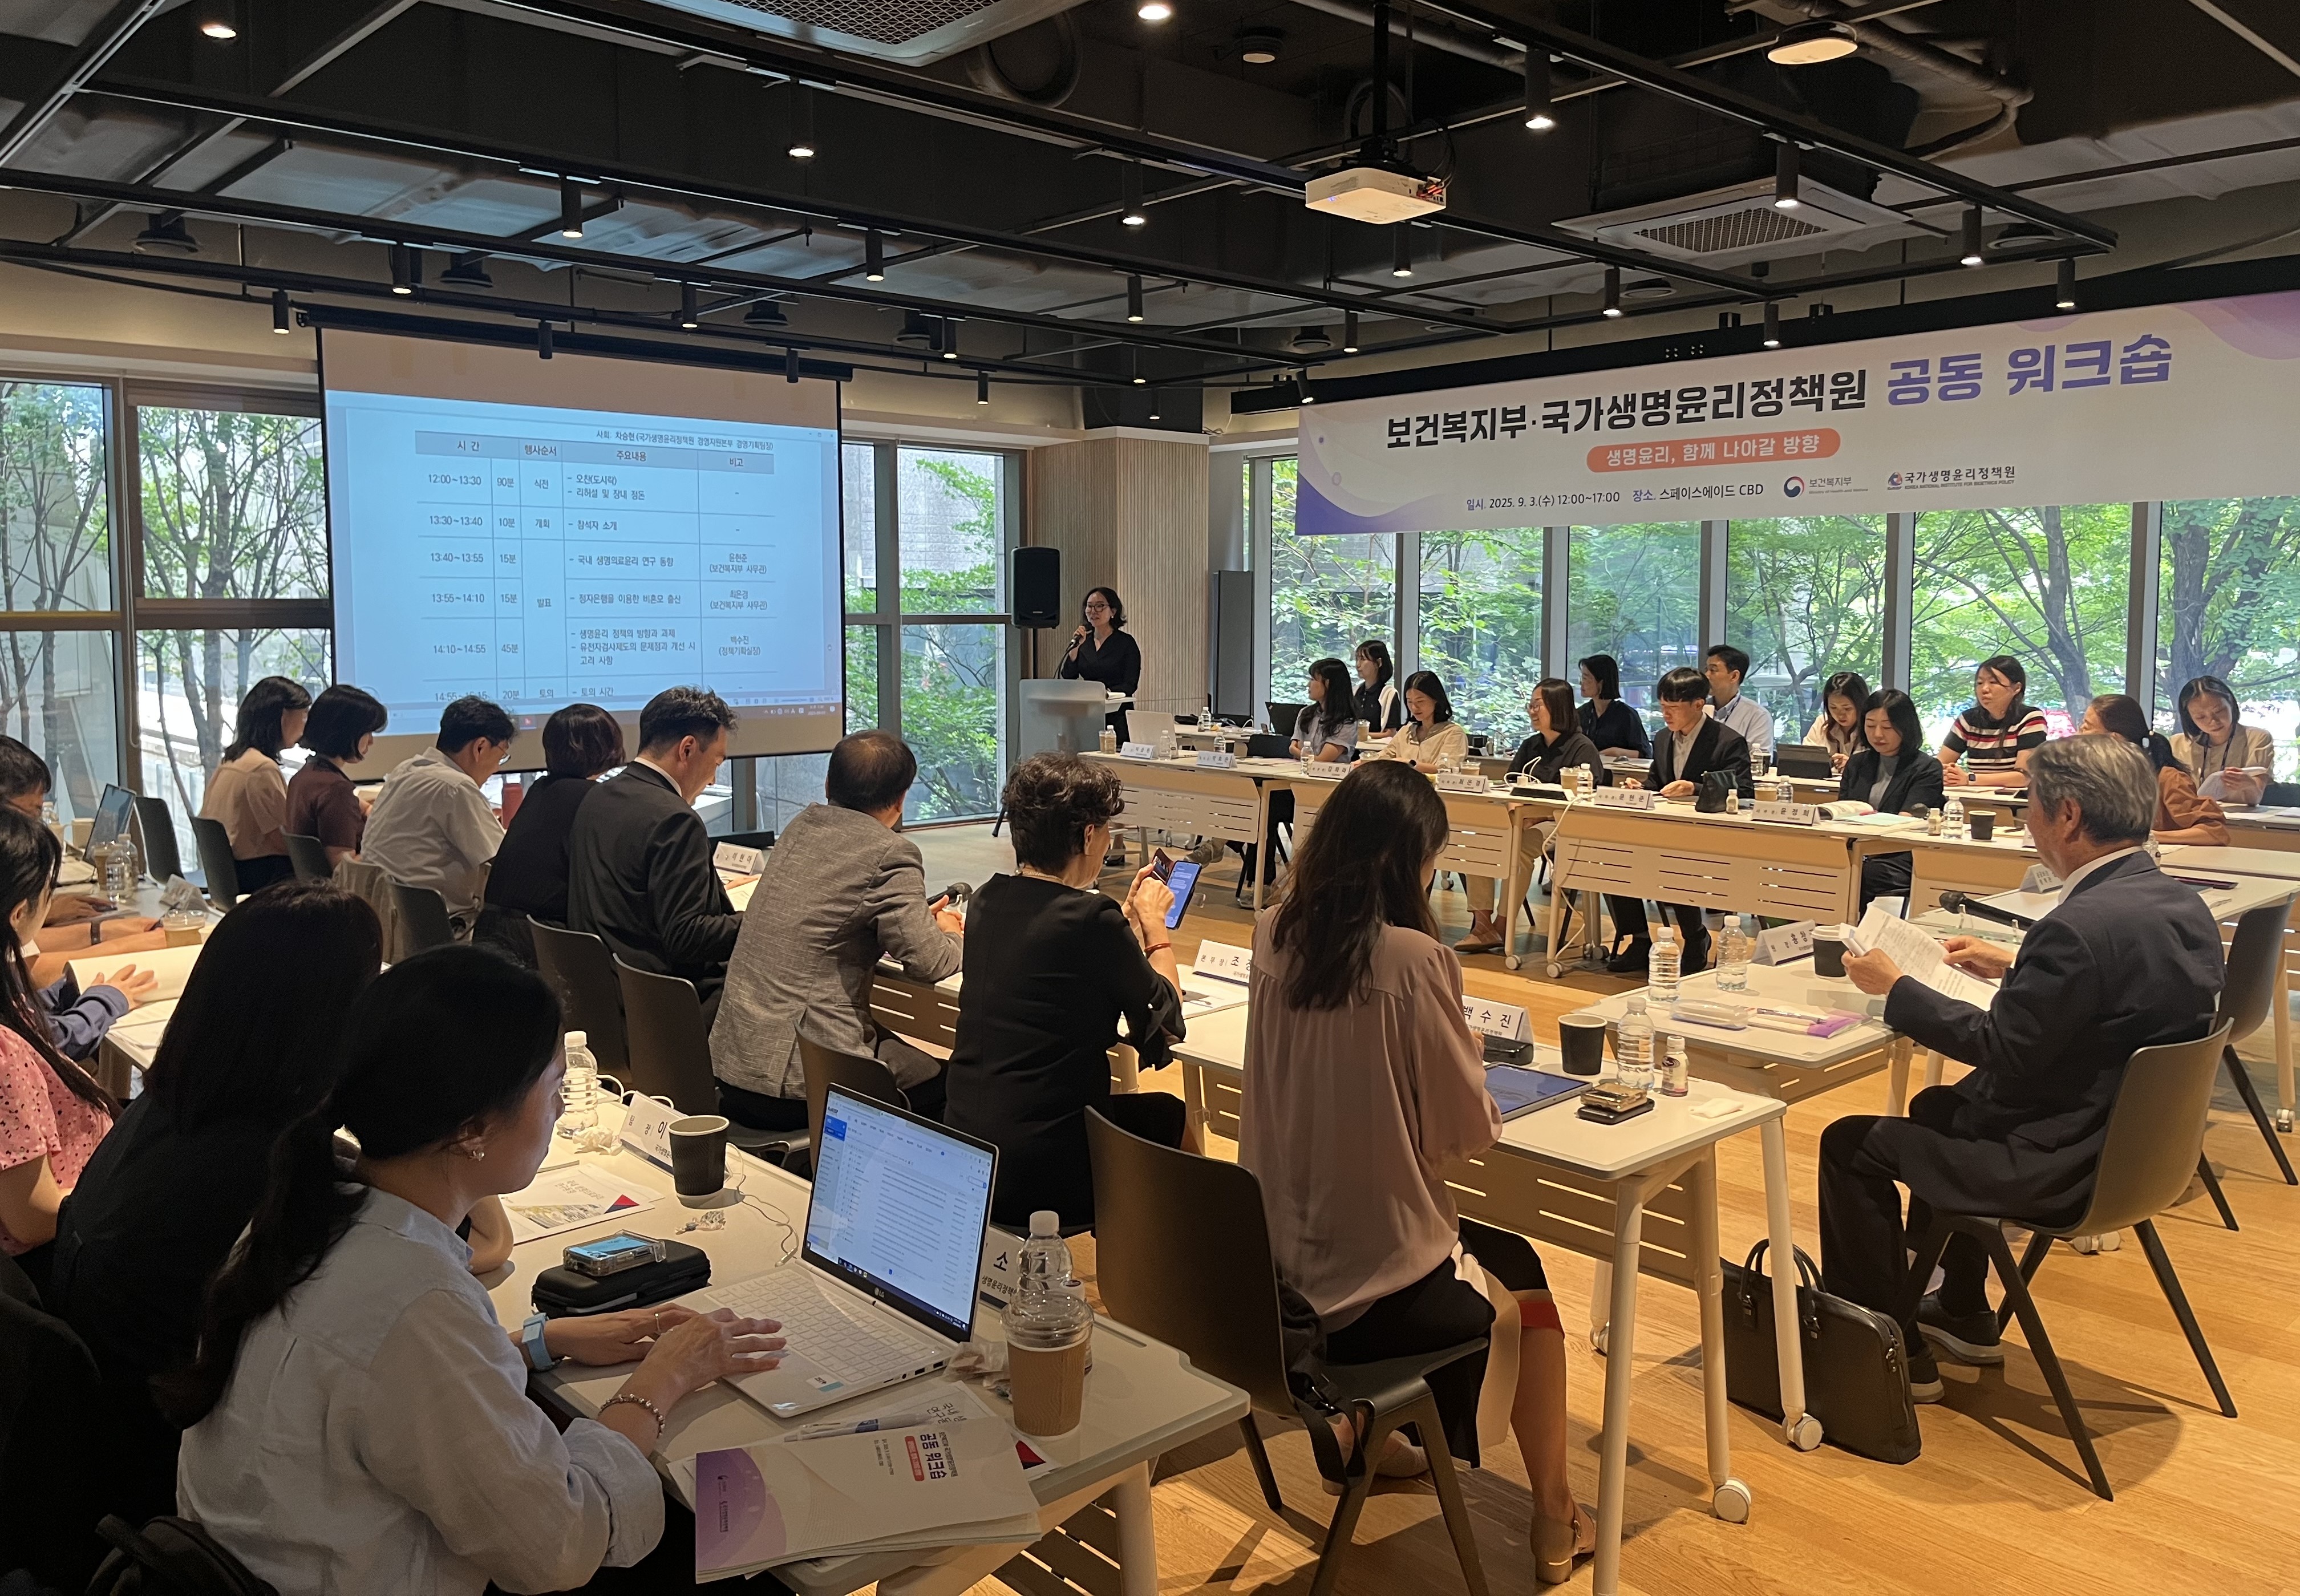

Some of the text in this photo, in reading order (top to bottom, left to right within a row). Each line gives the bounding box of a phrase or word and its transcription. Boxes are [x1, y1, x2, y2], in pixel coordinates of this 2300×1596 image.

[1387, 333, 2173, 449] 보건복지부·국가생명윤리정책원 공동 워크숍
[524, 444, 557, 456] 행사순서
[1606, 434, 1820, 467] 생명윤리, 함께 나아갈 방향
[616, 450, 647, 461] 주요내용
[729, 458, 743, 467] 비고
[428, 474, 481, 485] 12:00~13:30
[1904, 465, 2015, 484] 국가생명윤리정책원
[496, 477, 515, 488] 90분
[534, 479, 549, 489] 식전
[576, 475, 617, 485] 오찬(도시락)
[1809, 476, 1852, 488] 보건복지부
[577, 488, 645, 501] 리허설 및 장내 정돈
[1489, 496, 1515, 509] 2025.
[1517, 496, 1527, 508] 9.
[1529, 495, 1555, 508] 3.(수)
[1557, 491, 1621, 506] 12:00~17:00
[1659, 485, 1735, 500] 스페이스에이드
[1739, 484, 1764, 496] CBD
[430, 516, 483, 526] 13:30~13:40
[499, 517, 516, 528] 10분
[535, 519, 550, 529] 개회
[577, 520, 617, 530] 참석자 소개
[430, 553, 484, 563] 13:40~13:55
[500, 553, 517, 564] 15분
[578, 555, 674, 567] 국내 생명의료윤리 연구 동향
[709, 564, 767, 574] (보건복지부 사무관)
[432, 593, 485, 603] 13:55~14:10
[500, 593, 517, 603] 15분
[537, 598, 552, 608] 발표
[579, 594, 681, 604] 정자은행을 이용한 비혼모 출산
[710, 600, 768, 610] (보건복지부 사무관)
[580, 629, 675, 638] 생명윤리 정책의 방향과 과제
[433, 644, 486, 654] 14:10~14:55
[501, 643, 519, 654] 45분
[580, 642, 696, 653] 유전자검사제도의 문제점과 개선 시
[599, 656, 613, 666] 사항
[503, 690, 520, 700] 20분
[581, 686, 614, 697] 토의 시간
[920, 1433, 947, 1480] 공동 워크숍
